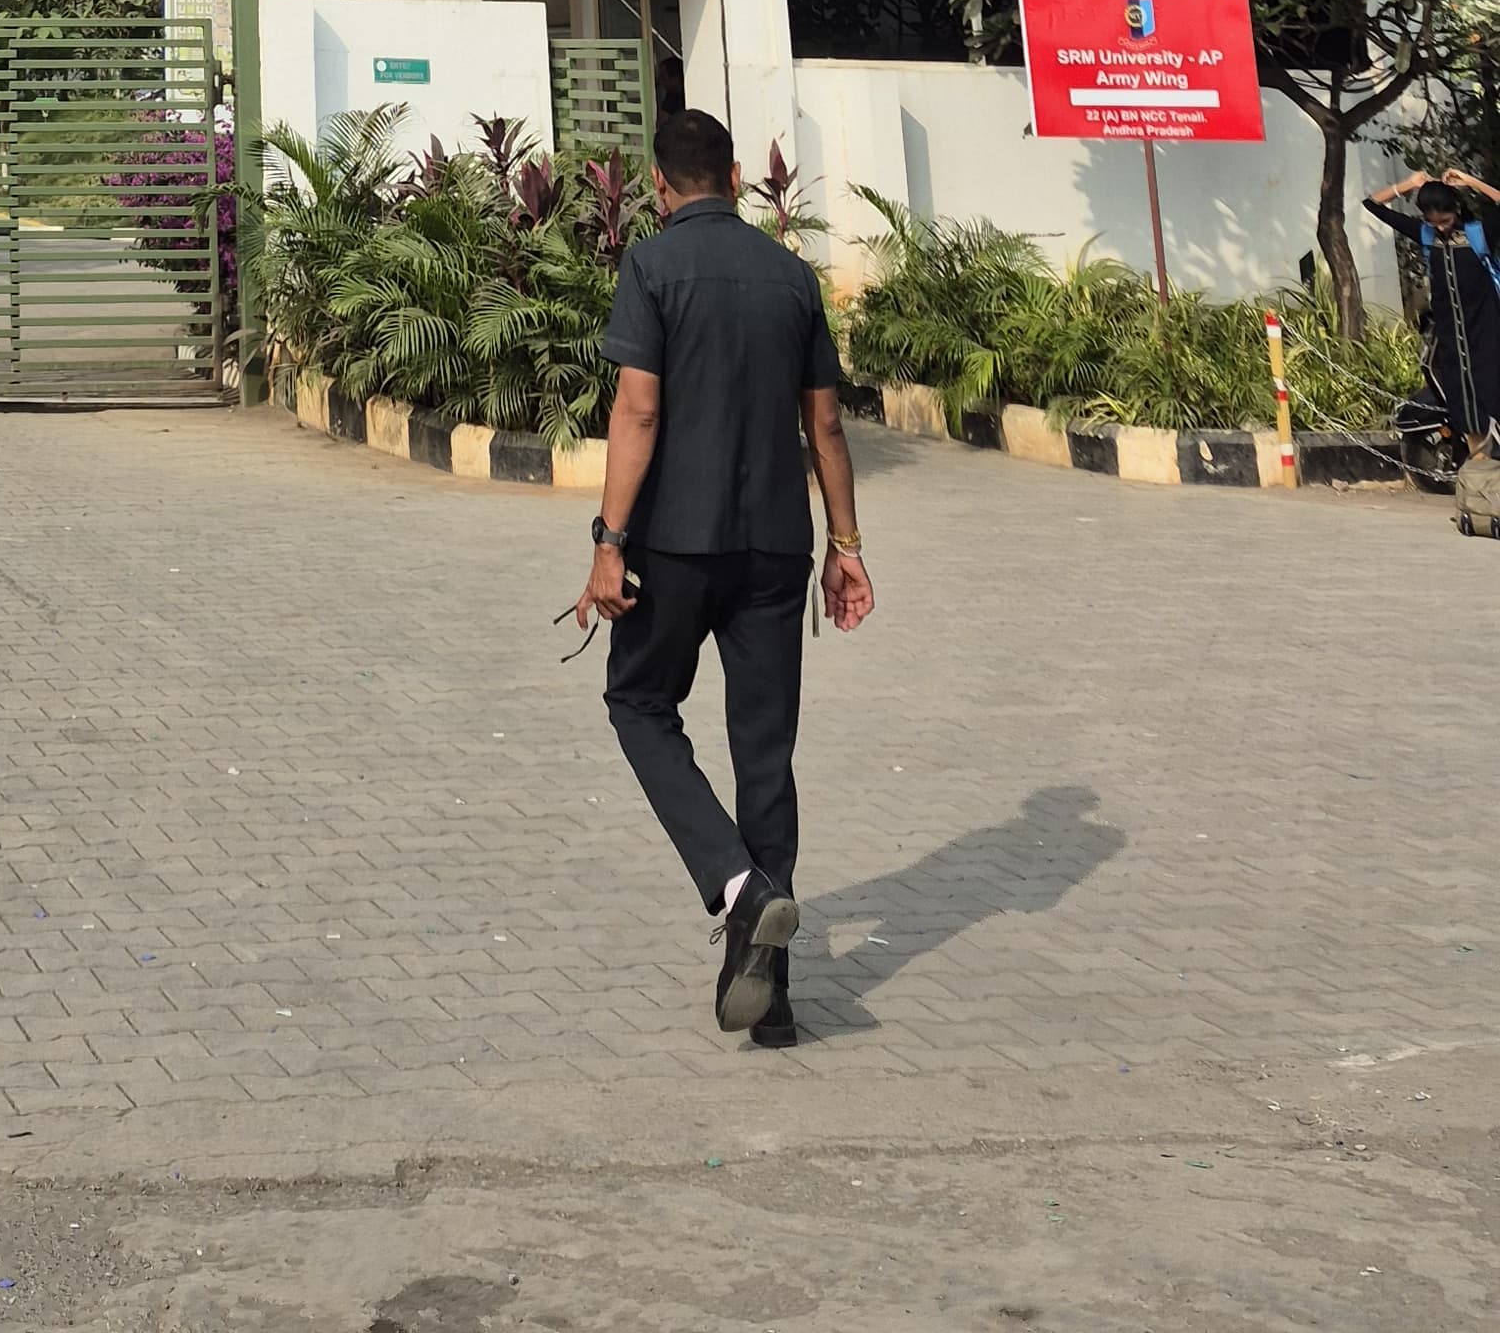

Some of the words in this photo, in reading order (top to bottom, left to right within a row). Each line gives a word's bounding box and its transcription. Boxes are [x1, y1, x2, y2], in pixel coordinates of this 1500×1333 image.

[1057, 49, 1095, 65] SRM
[1100, 50, 1183, 68] University
[1198, 50, 1223, 65] AP
[1096, 71, 1140, 88] Army
[1144, 71, 1189, 89] Wing
[1086, 109, 1100, 121] 22
[1102, 109, 1119, 123] (A)
[1121, 111, 1139, 121] BN
[1141, 111, 1167, 122] NCC
[1103, 124, 1144, 136] Andhra
[1147, 125, 1194, 137] Pradesh
